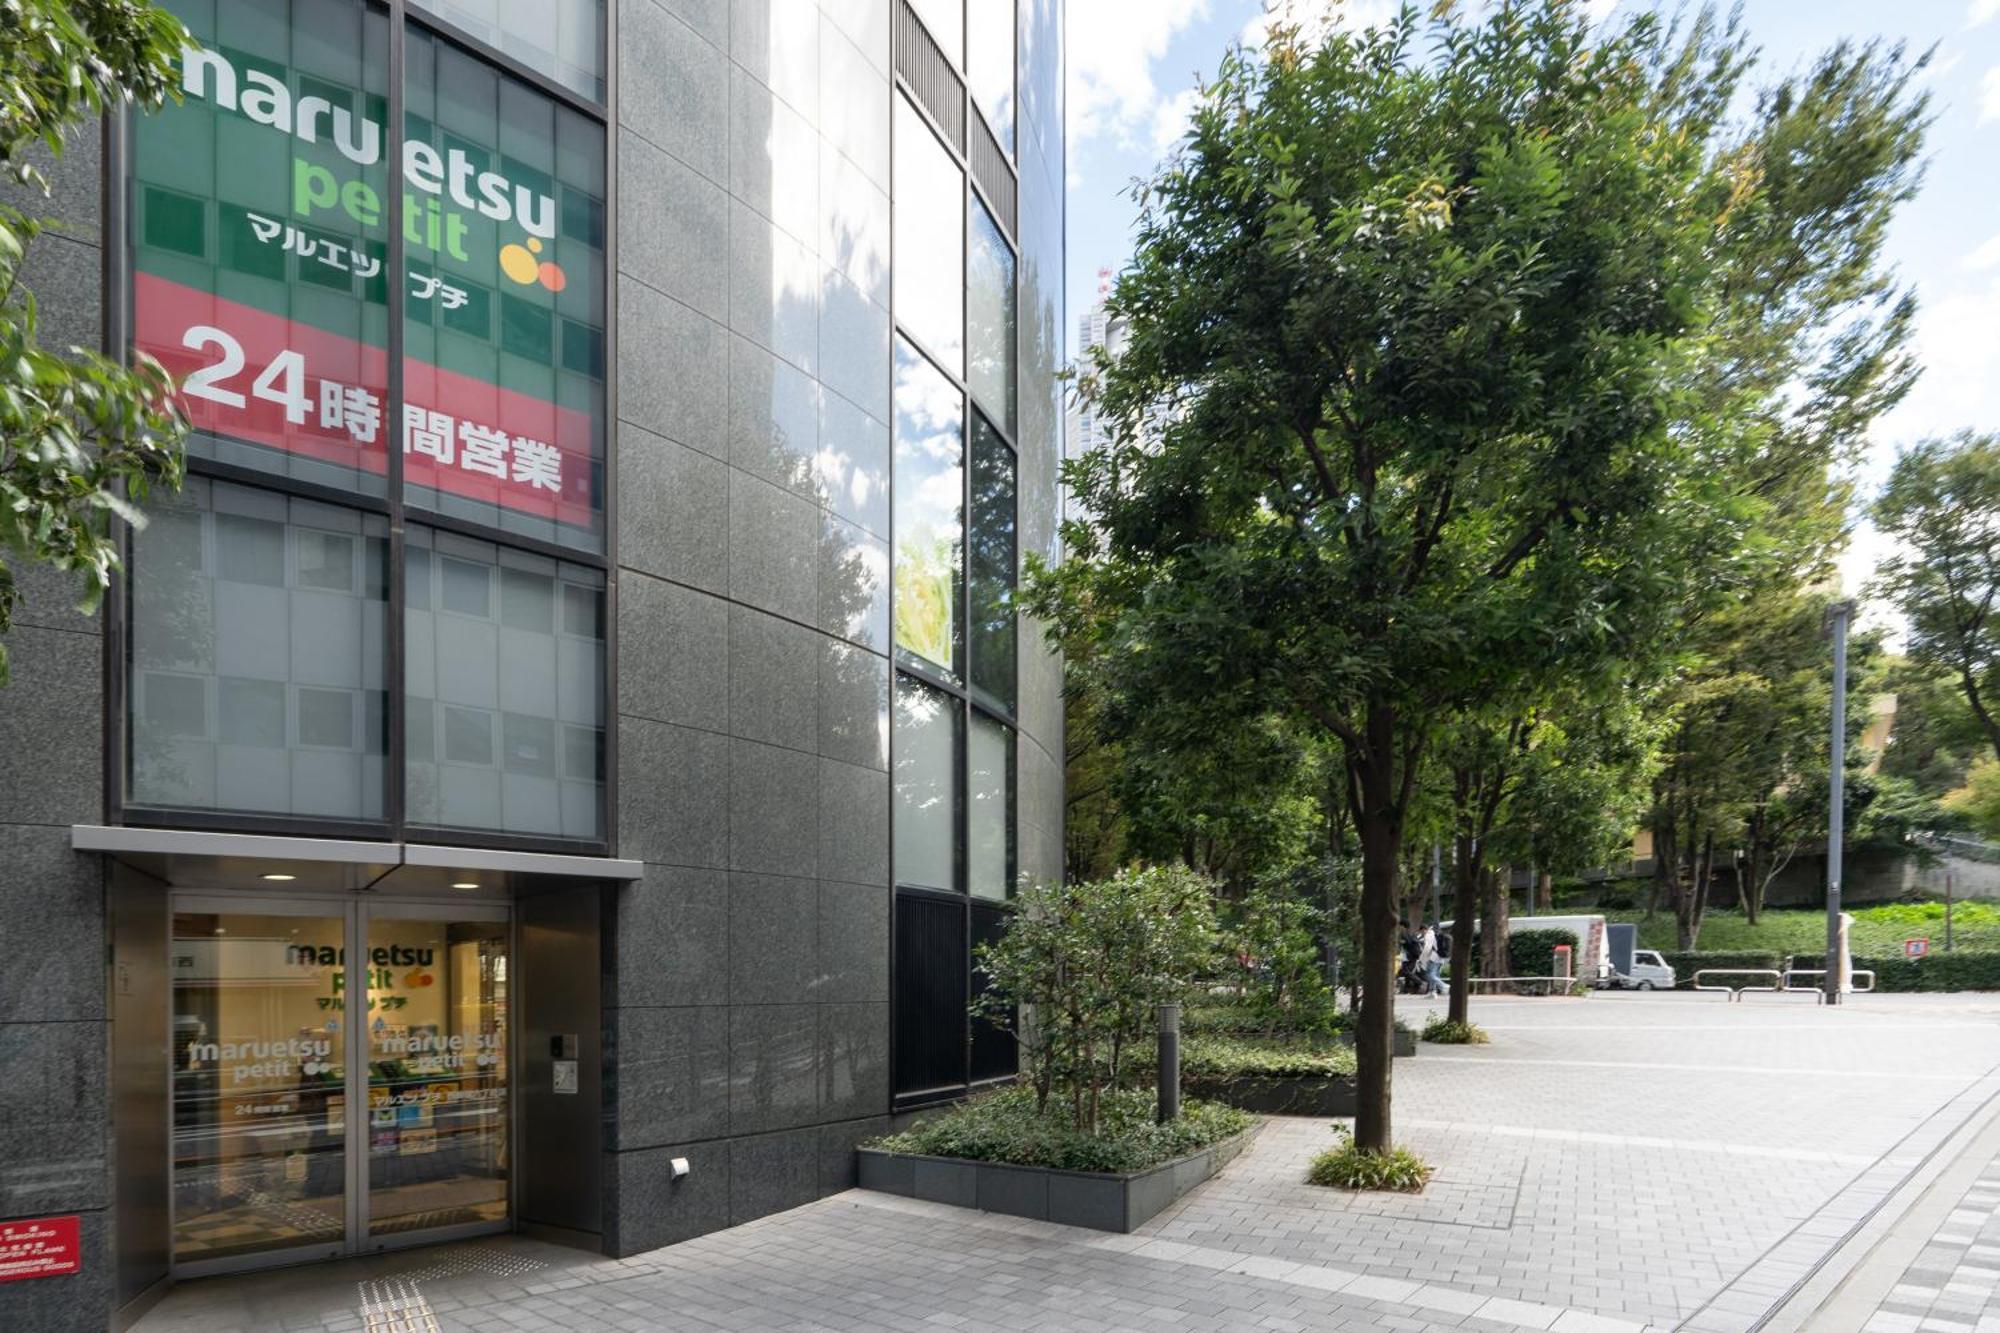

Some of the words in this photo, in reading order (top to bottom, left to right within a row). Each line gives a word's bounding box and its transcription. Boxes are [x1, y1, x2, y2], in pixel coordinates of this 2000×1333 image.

[293, 157, 469, 263] petit
[246, 212, 380, 279] マルエツ
[409, 271, 469, 310] プチ
[182, 325, 562, 493] 24時間営業
[190, 1039, 331, 1061] maruetsu
[234, 1060, 290, 1083] petit
